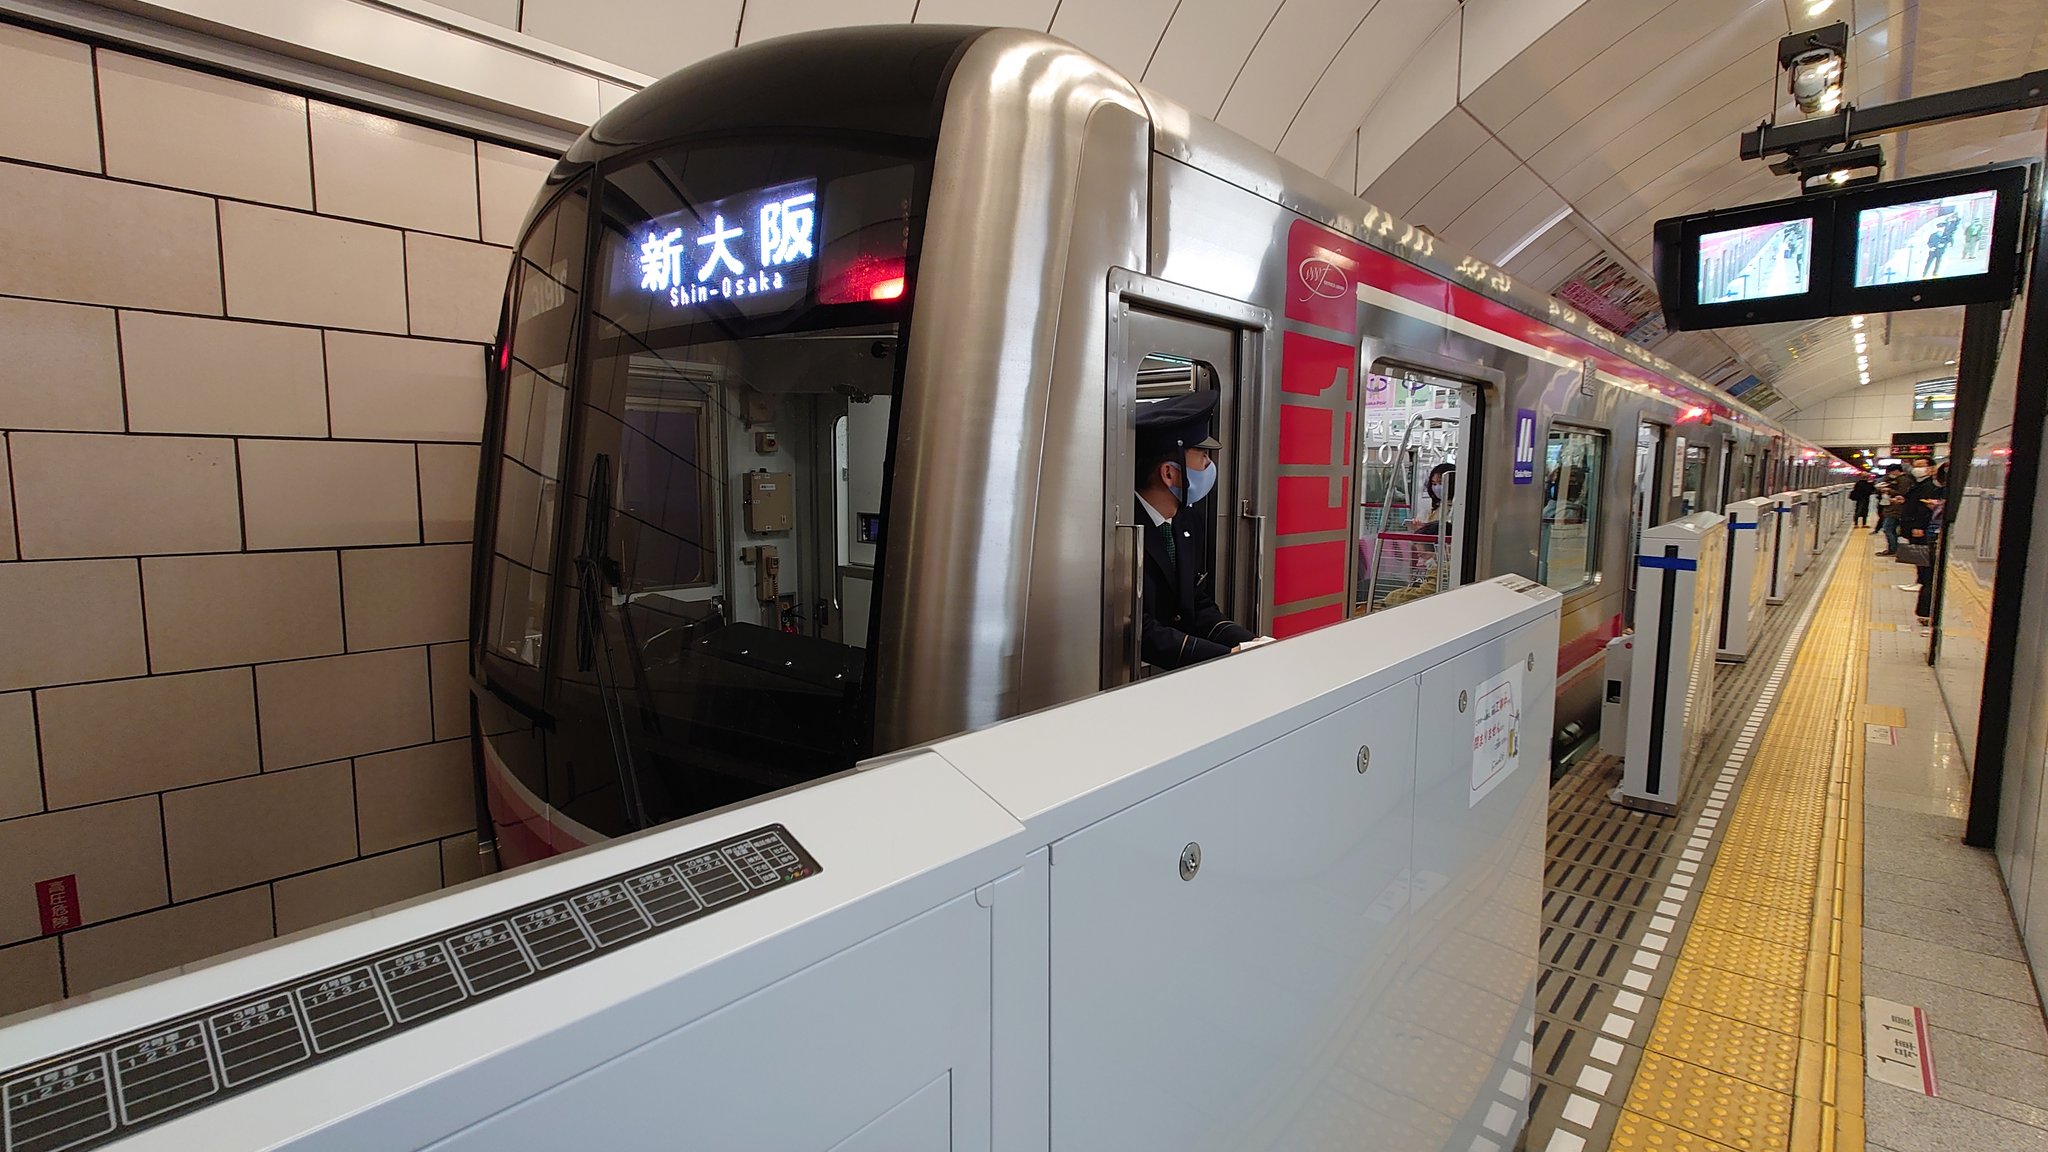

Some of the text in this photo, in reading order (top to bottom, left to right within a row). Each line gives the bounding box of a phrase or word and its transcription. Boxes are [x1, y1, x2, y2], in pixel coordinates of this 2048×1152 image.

[640, 192, 815, 292] 新大阪
[670, 270, 783, 307] Shin-Osaka
[685, 855, 711, 867] 10号車
[638, 872, 662, 884] 9号車
[48, 880, 69, 929] 高圧危険
[527, 908, 555, 921] 7号車
[464, 928, 493, 942] 6号車
[390, 956, 440, 978] 1 2 3 4
[395, 951, 426, 967] 5号車
[311, 980, 367, 1005] 1 2 3 4
[319, 975, 352, 992] 4号車
[223, 1007, 287, 1034] 1 2 3 4
[232, 1002, 270, 1020] 3号車
[128, 1038, 196, 1068] 1 2 3 4
[138, 1032, 179, 1053] 2号車
[1876, 1038, 1917, 1068] 1号車
[33, 1065, 79, 1088] 1号車
[20, 1072, 96, 1105] 1 2 3 4
